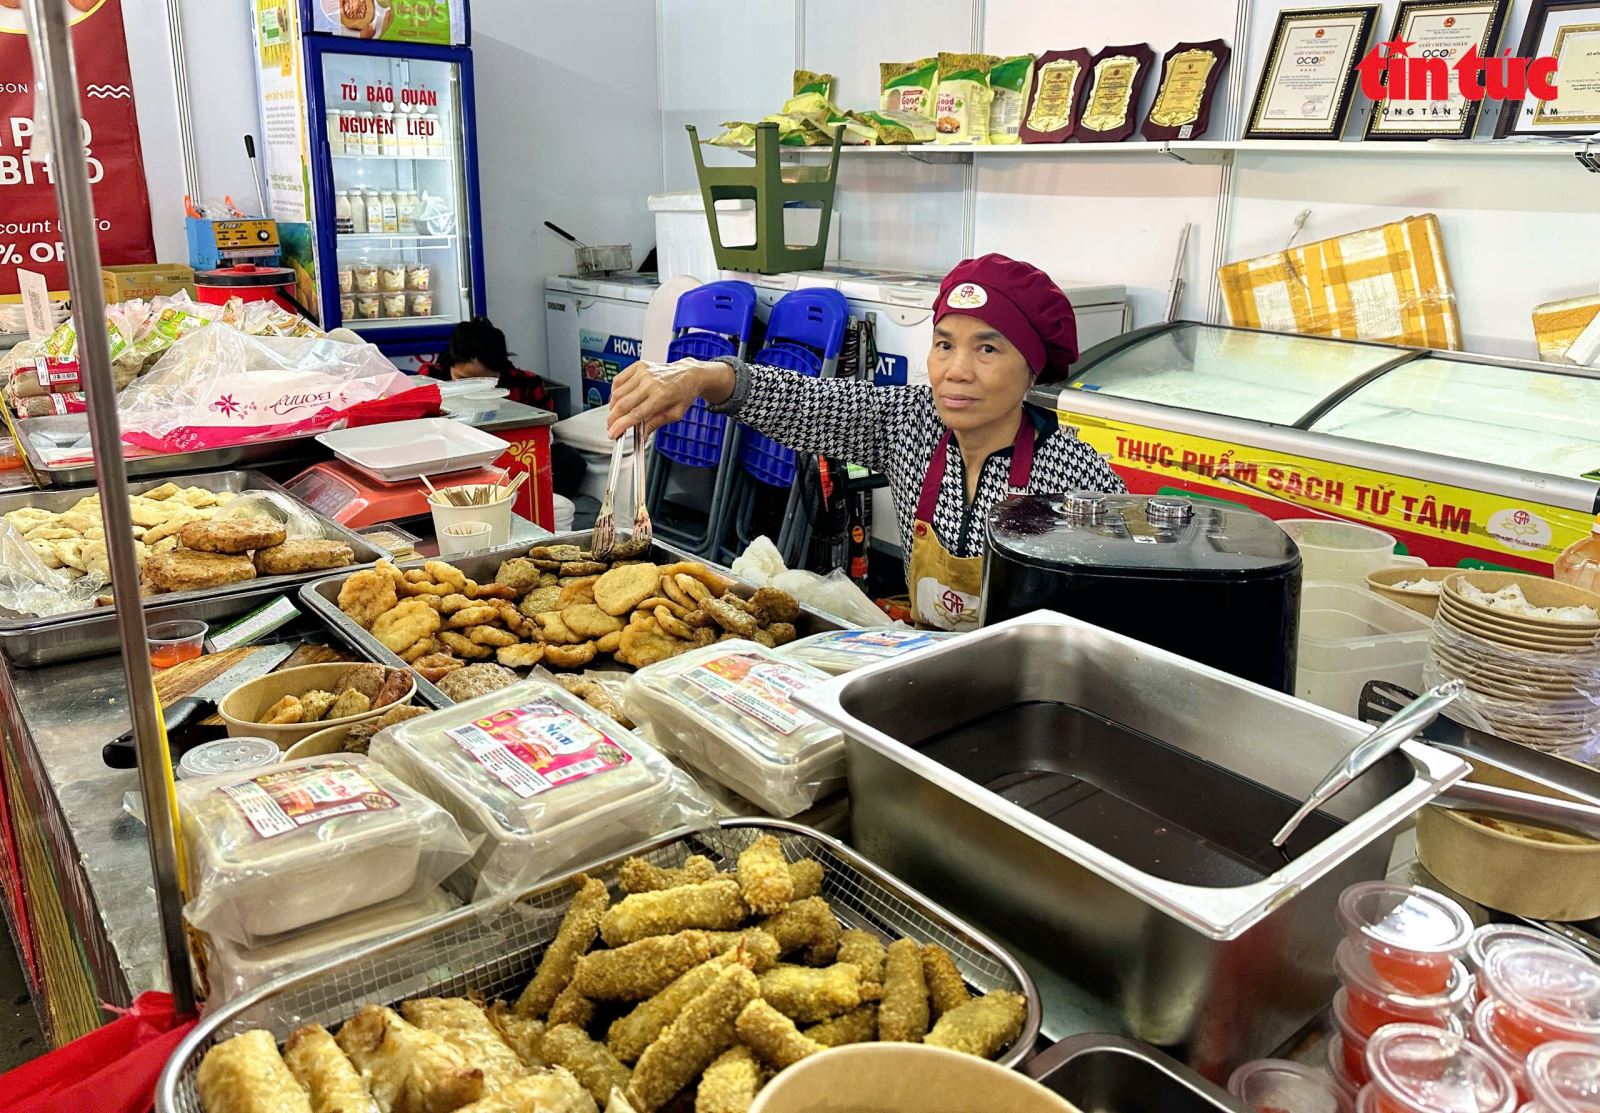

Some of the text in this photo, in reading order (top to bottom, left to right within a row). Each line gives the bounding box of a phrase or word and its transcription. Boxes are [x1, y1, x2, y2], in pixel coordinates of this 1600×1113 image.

[1296, 56, 1327, 65] OCOP
[1422, 48, 1457, 58] OCOP
[341, 77, 437, 106] TỦ BẢO QUẢN
[339, 114, 434, 139] NGUYÊN LIỆU
[1116, 436, 1472, 535] THỰC PHẨM SẠCH TỪ TÂM
